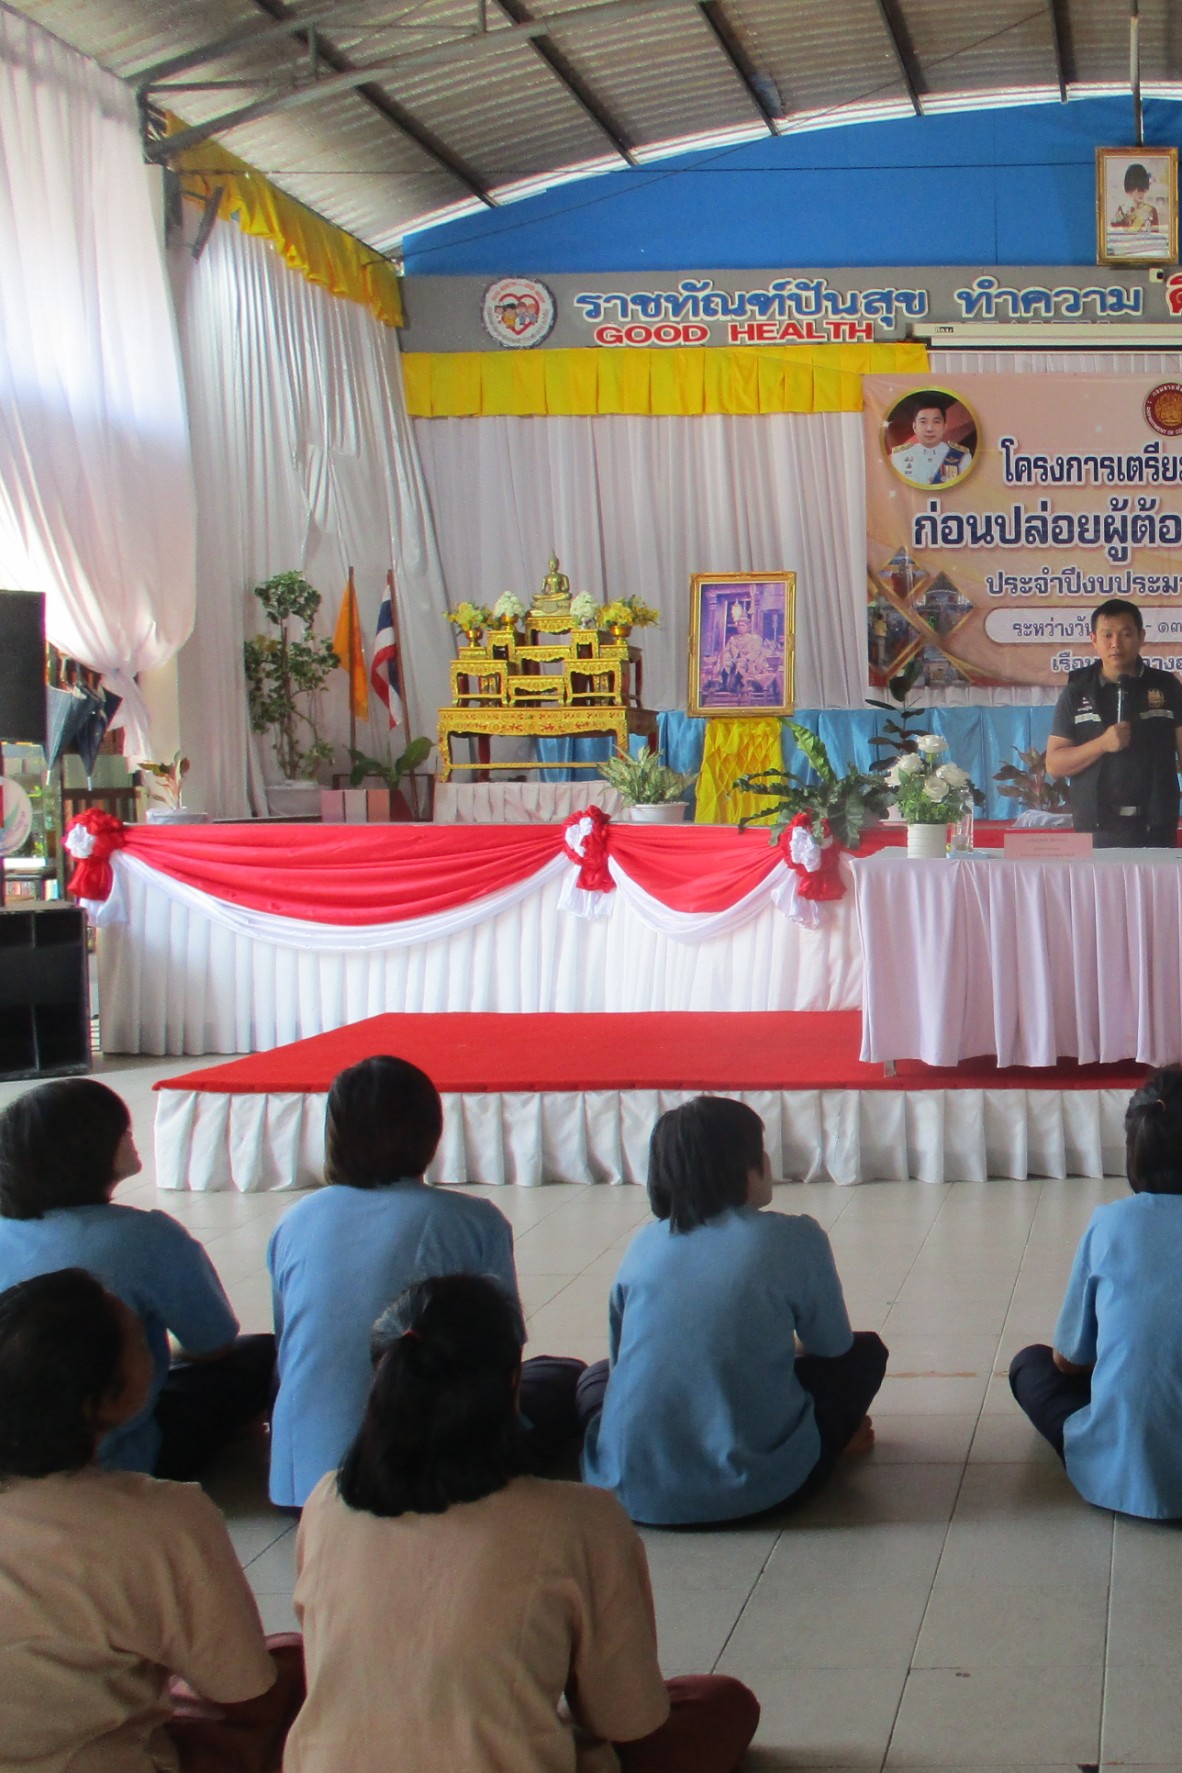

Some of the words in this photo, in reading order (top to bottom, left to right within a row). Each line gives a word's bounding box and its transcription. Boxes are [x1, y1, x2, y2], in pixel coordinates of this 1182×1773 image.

[575, 277, 929, 330] ราชทัณฑ์ปันสุข
[953, 275, 1144, 318] ทำความ
[594, 322, 710, 347] GOOD
[728, 320, 874, 343] HEALTH
